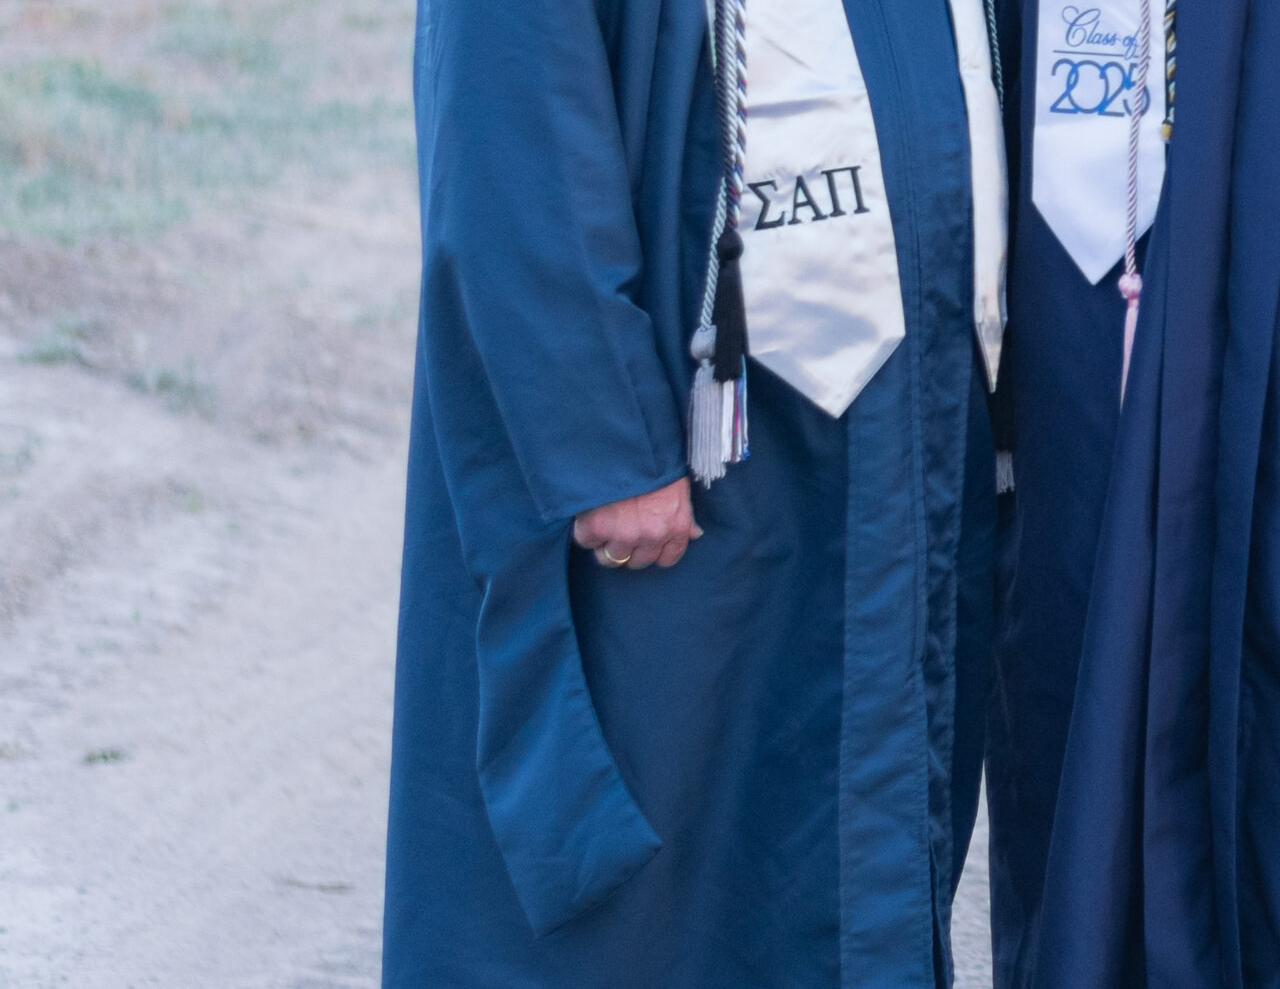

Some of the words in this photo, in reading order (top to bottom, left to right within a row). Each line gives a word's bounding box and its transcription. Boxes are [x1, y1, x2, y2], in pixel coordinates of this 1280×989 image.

[1061, 5, 1120, 48] Class
[1122, 24, 1144, 61] of
[1050, 58, 1151, 118] 2025
[747, 165, 871, 231] ΣΑΠ
